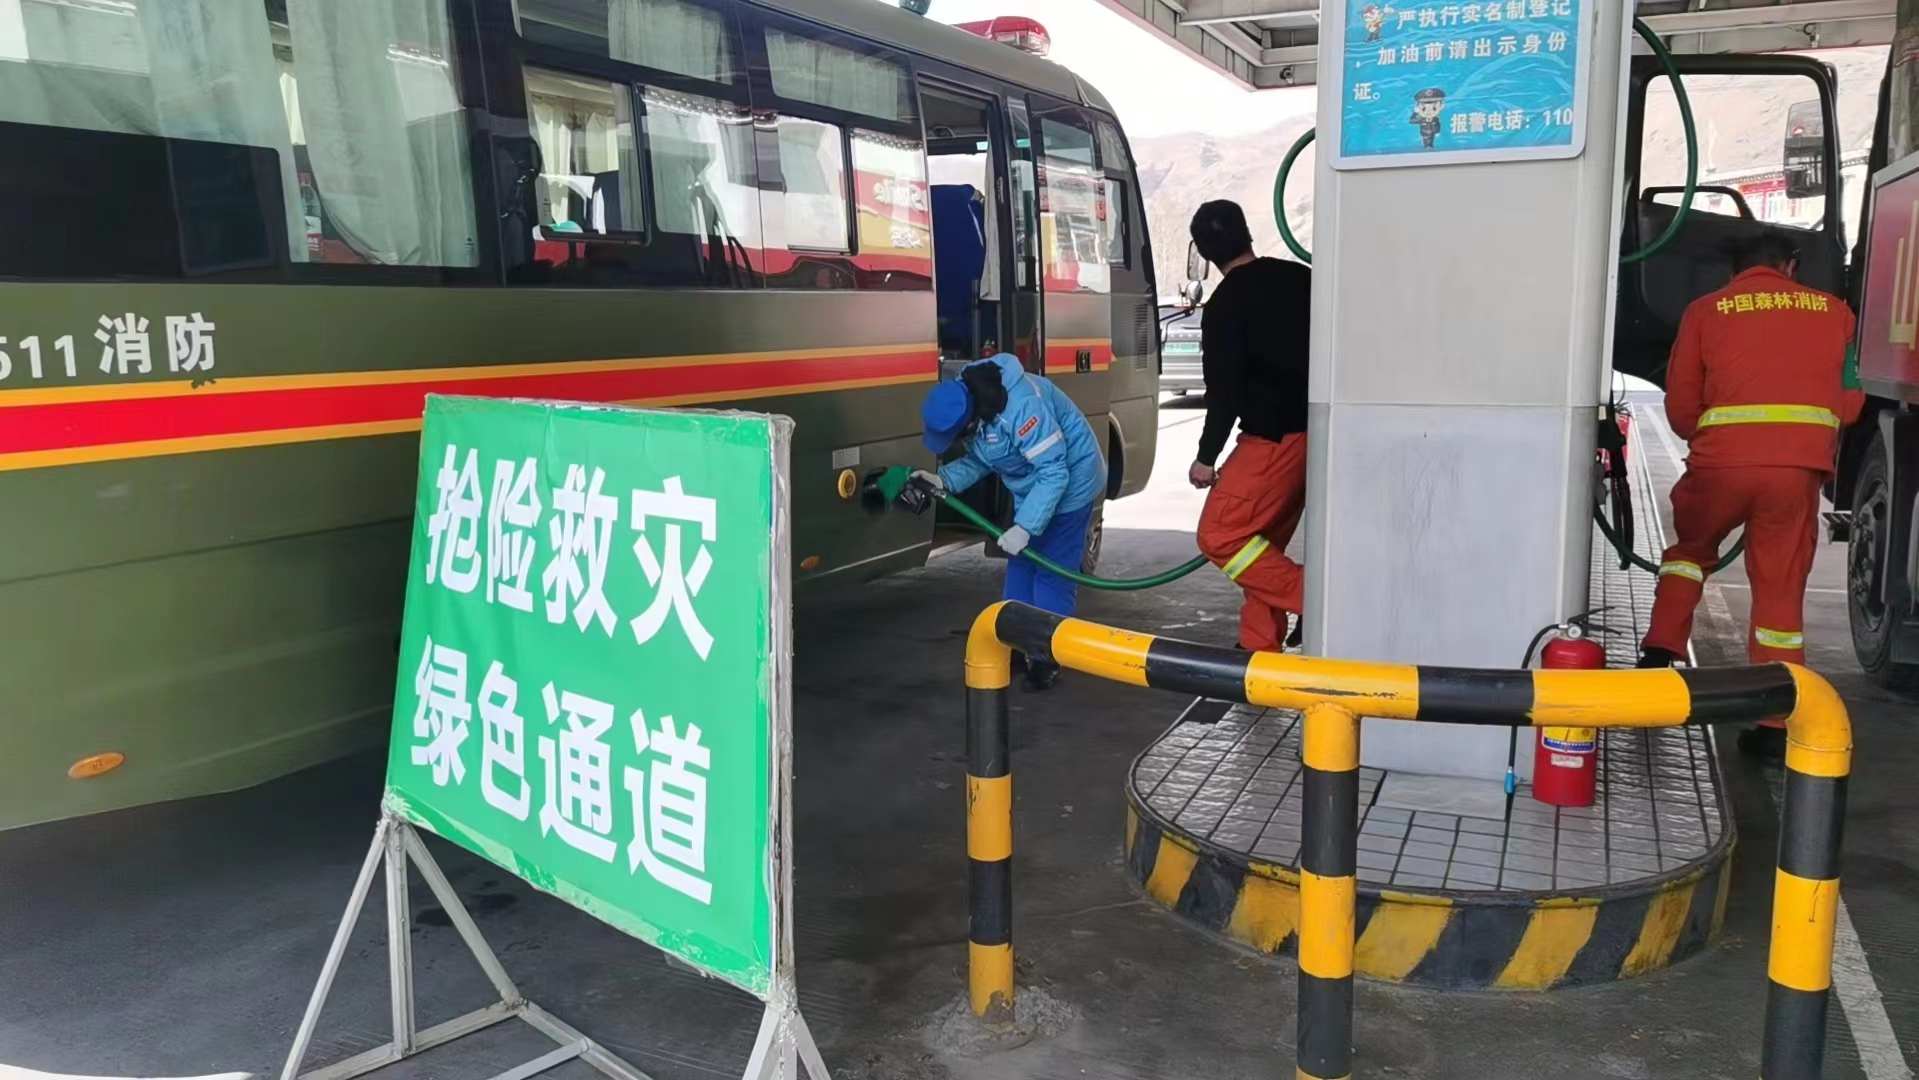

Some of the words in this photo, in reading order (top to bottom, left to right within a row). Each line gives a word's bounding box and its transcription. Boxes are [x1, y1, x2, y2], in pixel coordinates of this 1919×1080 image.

[1542, 107, 1573, 126] 110
[1716, 291, 1828, 315] 中国森林消防
[94, 312, 216, 374] 消防
[426, 443, 717, 662] 抢险救灾
[410, 634, 713, 905] 绿色通道
